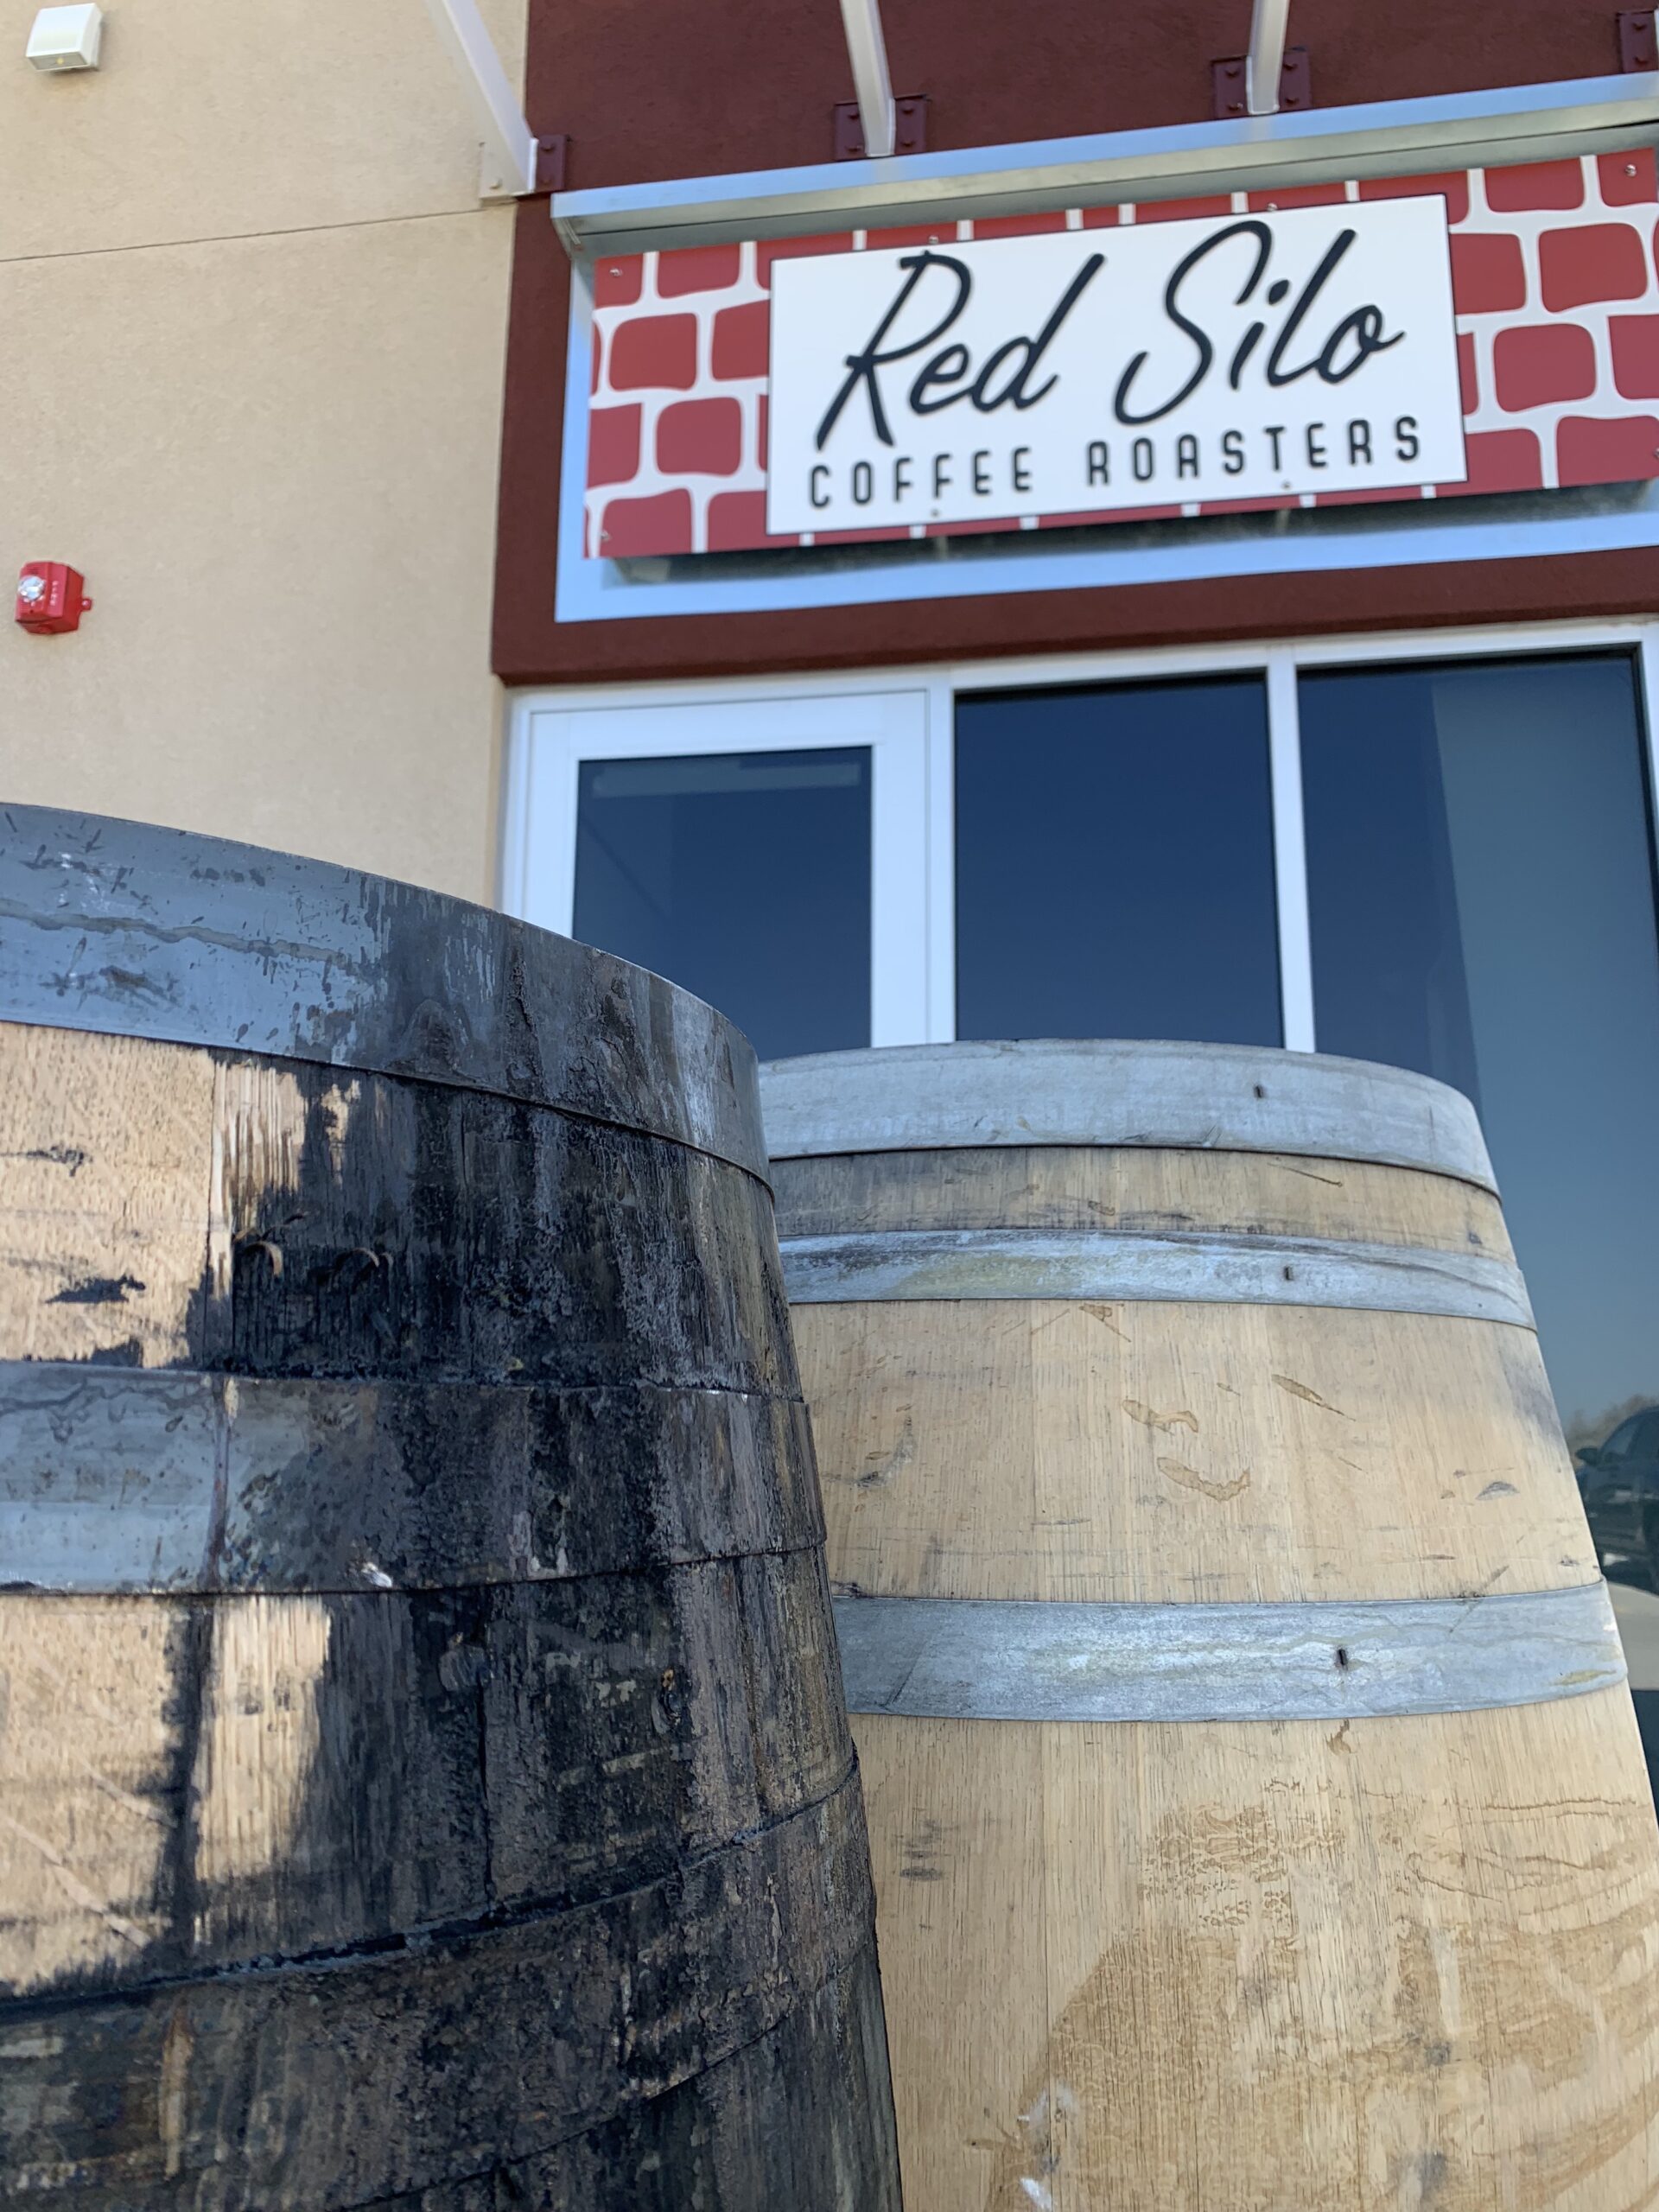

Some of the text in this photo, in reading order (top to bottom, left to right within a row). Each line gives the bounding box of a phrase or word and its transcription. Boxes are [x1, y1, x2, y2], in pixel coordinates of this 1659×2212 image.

[816, 219, 1405, 451] Red Silo
[810, 416, 1420, 508] COFFEE ROASTERS
